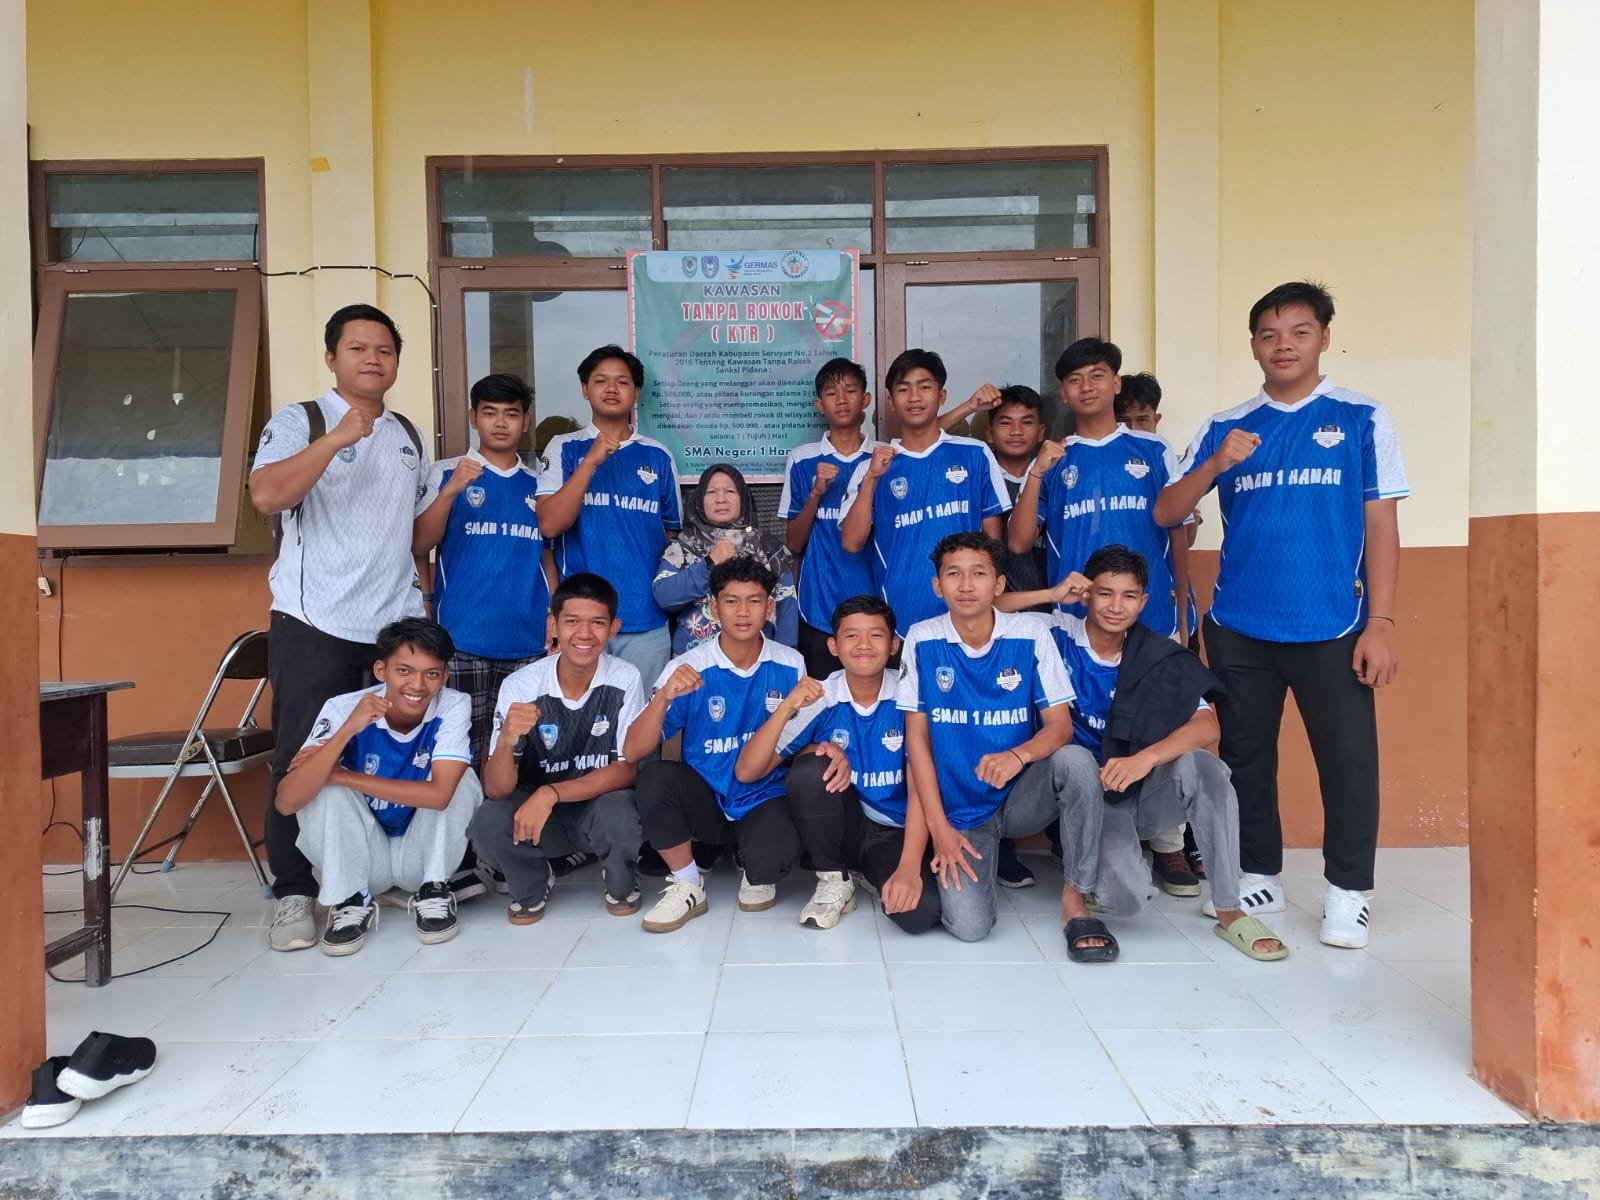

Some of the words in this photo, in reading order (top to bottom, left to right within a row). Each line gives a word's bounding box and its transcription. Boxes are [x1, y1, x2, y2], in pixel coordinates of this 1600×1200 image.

[744, 261, 779, 269] GERMAS
[703, 285, 781, 297] KAWASAN
[681, 302, 738, 321] TANPA
[746, 301, 805, 321] ROKOK
[726, 324, 761, 343] KTR
[649, 350, 688, 358] Peraturan
[689, 350, 717, 358] Daerah
[718, 350, 760, 359] Kabupaten
[761, 350, 793, 359] Seruyan
[695, 359, 726, 367] Tentang
[727, 358, 761, 366] Kawasan
[719, 380, 756, 388] melanggar
[784, 412, 812, 420] wilayah
[781, 422, 806, 430] pidana
[747, 433, 767, 441] Tujuh
[684, 446, 712, 457] SMA
[715, 446, 757, 460] Negeri
[760, 446, 766, 456] 1
[1234, 471, 1273, 493] SMAN
[1276, 469, 1284, 486] 1
[1288, 467, 1342, 486] HANAU
[582, 492, 610, 506] MAN
[613, 494, 621, 507] 1
[620, 496, 659, 515] HANAU
[1063, 499, 1096, 520] SMAN
[1099, 497, 1107, 511] 1
[816, 507, 841, 520] MAN
[894, 509, 924, 529] SMAN
[925, 506, 934, 519] 1
[935, 500, 969, 518] HANU
[464, 522, 497, 536] SMAN
[501, 522, 508, 535] 1
[931, 707, 968, 724] SMAN
[972, 709, 980, 725] 1
[983, 707, 1029, 726] HANAU
[870, 769, 904, 787] HANA
